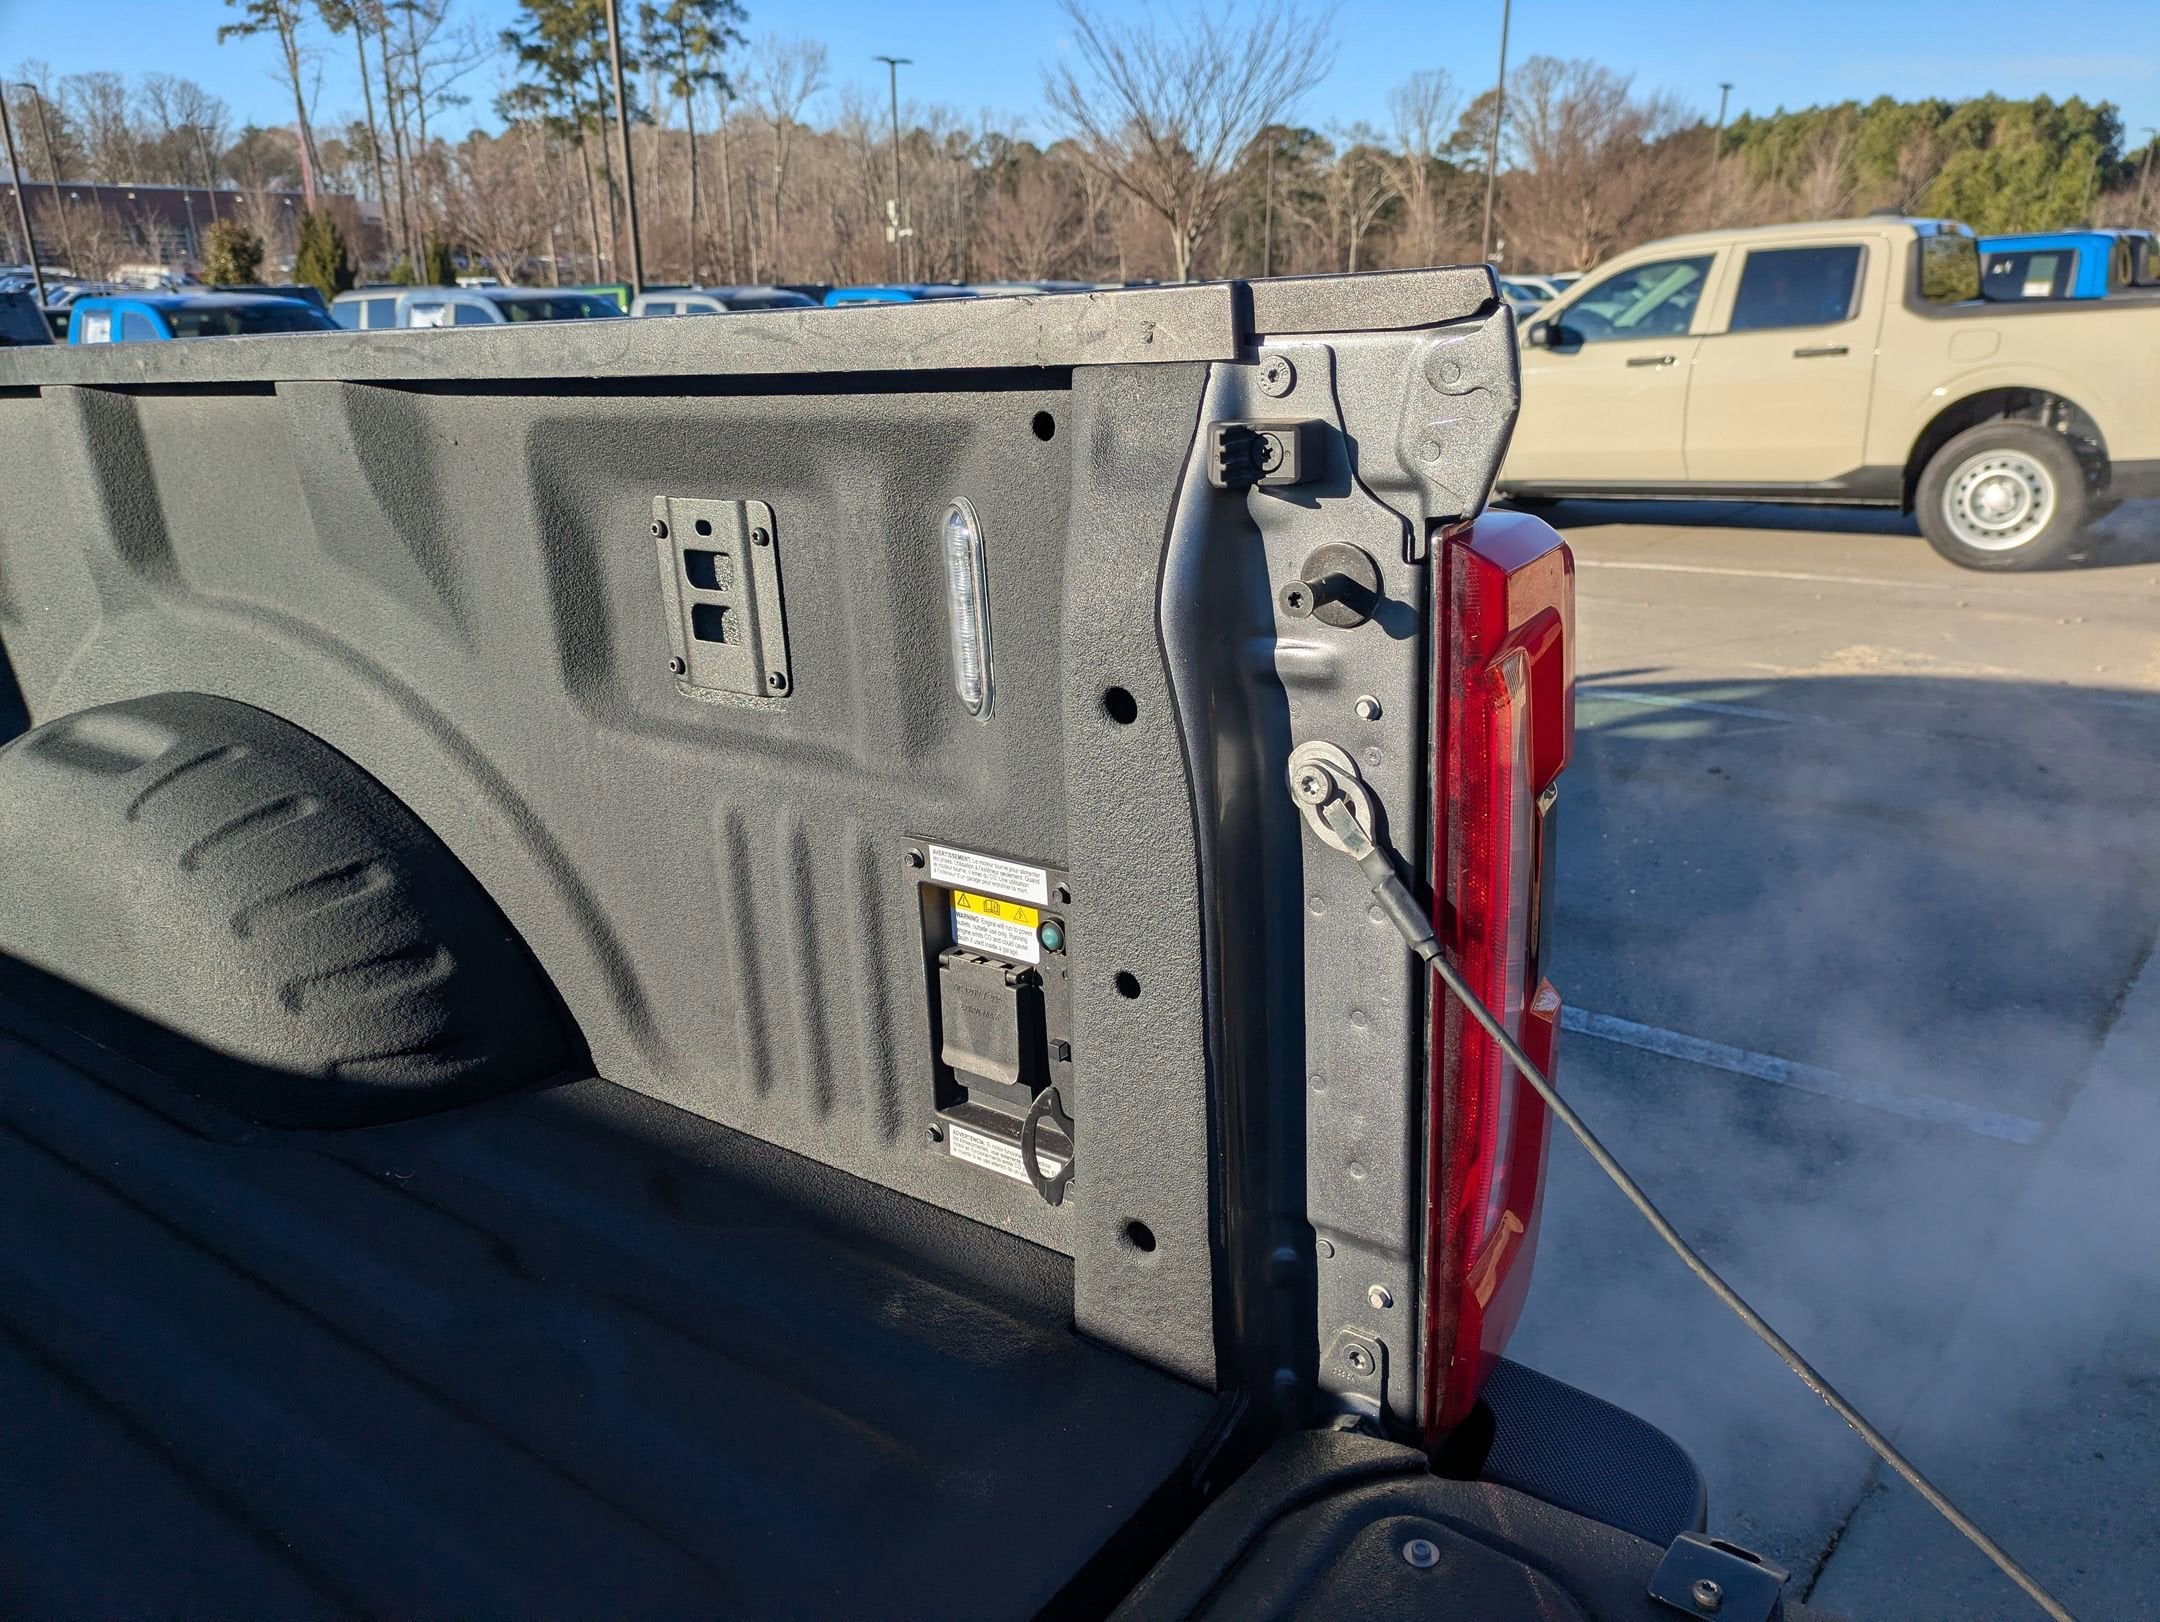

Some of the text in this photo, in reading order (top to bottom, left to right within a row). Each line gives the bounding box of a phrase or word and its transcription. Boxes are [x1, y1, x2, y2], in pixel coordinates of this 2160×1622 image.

[994, 863, 1007, 871] tourne
[1019, 868, 1040, 878] alimenter
[966, 875, 980, 883] garage
[1024, 875, 1039, 884] Quand
[972, 923, 988, 932] outside
[1008, 932, 1027, 944] Running
[980, 917, 996, 928] Engine
[996, 921, 1004, 929] will
[1018, 928, 1032, 936] power
[971, 930, 983, 938] emits
[1001, 938, 1014, 947] could
[1014, 942, 1028, 950] cause
[984, 941, 997, 950] inside
